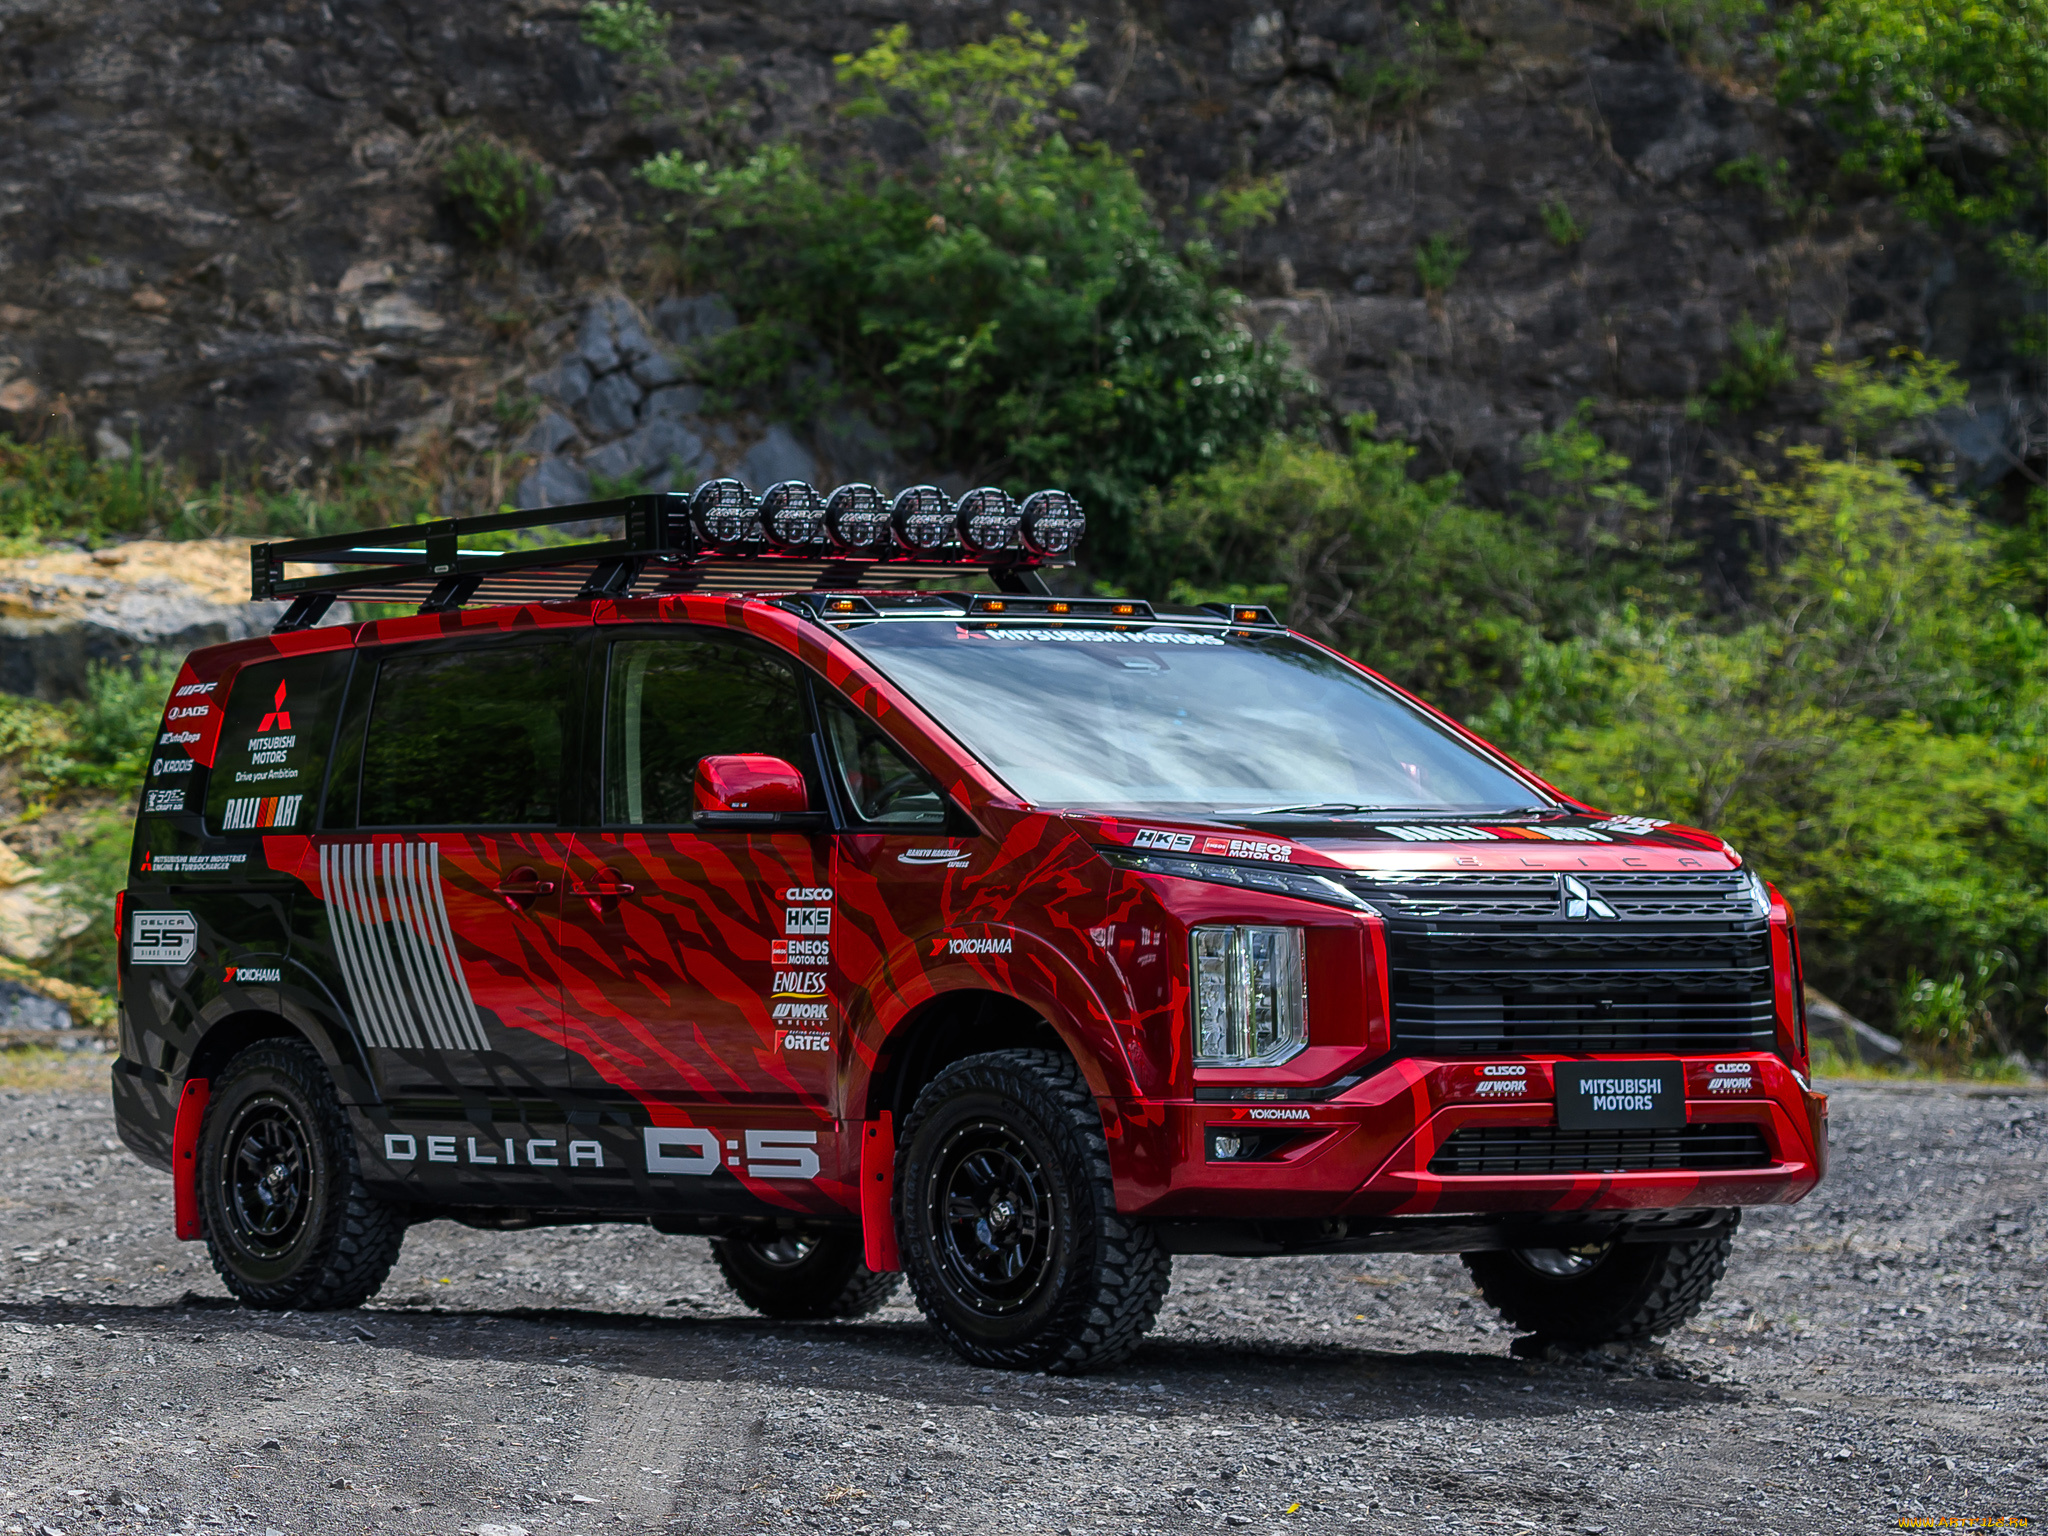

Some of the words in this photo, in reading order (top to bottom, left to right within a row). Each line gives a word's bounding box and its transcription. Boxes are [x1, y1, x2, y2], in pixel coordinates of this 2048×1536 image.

[985, 629, 1129, 643] MITSUBISHI
[1124, 631, 1225, 646] MOTORS
[248, 735, 296, 751] MITSUBISHI
[252, 750, 287, 765] MOTORS
[235, 771, 253, 782] Drive
[253, 772, 268, 783] your
[268, 768, 299, 780] Ambition
[1136, 830, 1193, 847] HKS
[1230, 839, 1292, 856] ENEOS
[153, 855, 188, 863] MITSUBISHI
[188, 855, 209, 863] HEAVY
[210, 854, 247, 863] INDUSTRIES
[1229, 849, 1269, 861] MOTOR
[1271, 854, 1290, 863] OIL
[152, 863, 174, 871] ENGINE
[181, 862, 230, 871] TURBOCHARGER
[786, 887, 833, 901] CUSCO
[786, 909, 830, 927] HKS
[133, 929, 195, 947] 55
[788, 940, 830, 955] ENEOS
[948, 938, 1012, 954] YOKOHAMA
[788, 955, 815, 965] MOTOR
[816, 955, 829, 965] OIL
[236, 968, 281, 982] YOKOHAMA
[772, 971, 827, 993] ENDLESS
[791, 1003, 829, 1018] WORK
[1483, 1065, 1526, 1076] CUSCO
[1715, 1063, 1751, 1073] CUSCO
[1493, 1080, 1527, 1092] WORK
[1579, 1078, 1662, 1095] MITSUBISHI
[1723, 1077, 1752, 1089] WORK
[1593, 1095, 1653, 1111] MOTORS
[1249, 1109, 1311, 1120] YOKOHAMA
[384, 1134, 604, 1167] DELICA
[643, 1127, 820, 1179] D:5
